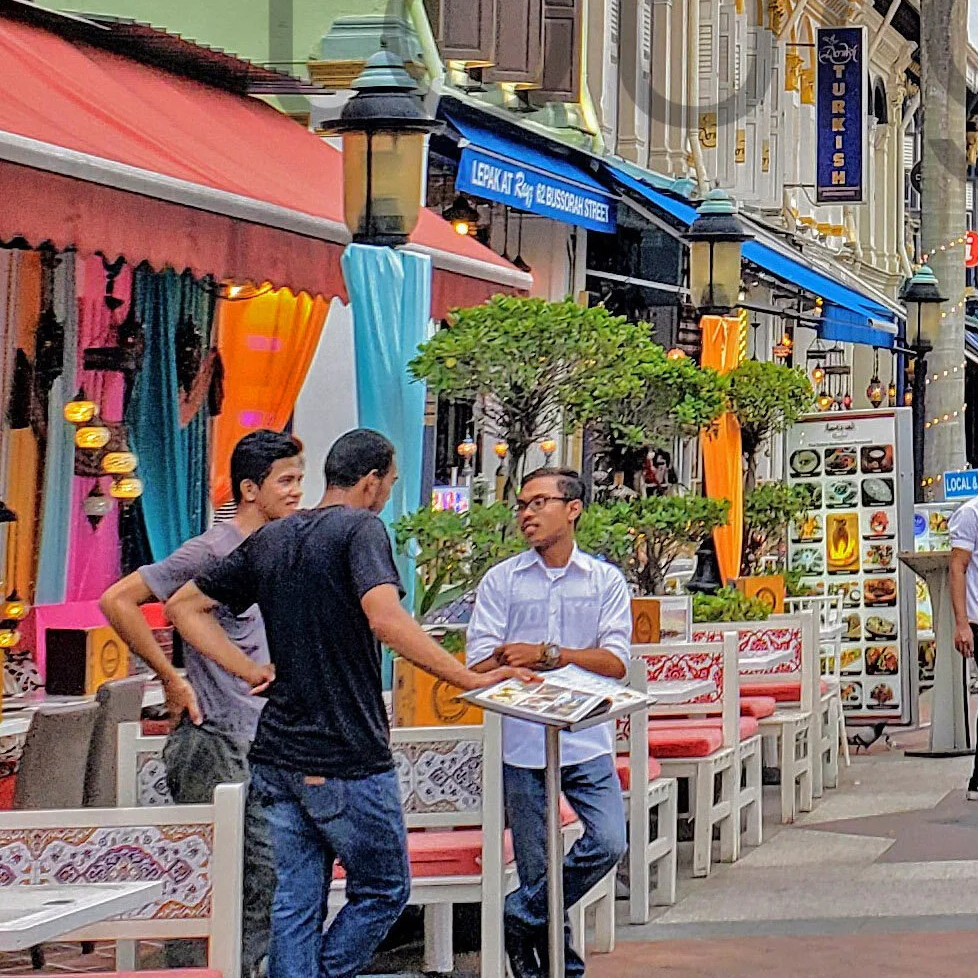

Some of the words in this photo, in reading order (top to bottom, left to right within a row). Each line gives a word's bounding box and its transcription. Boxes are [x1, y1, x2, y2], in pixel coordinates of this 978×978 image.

[832, 65, 846, 185] TURKISH
[471, 159, 501, 193] LEPAK
[501, 171, 513, 195] AT
[536, 182, 546, 204] 62
[545, 186, 584, 216] BUSSORAH
[584, 200, 610, 223] STREET
[946, 476, 971, 492] LOCAL
[972, 475, 978, 490] &
